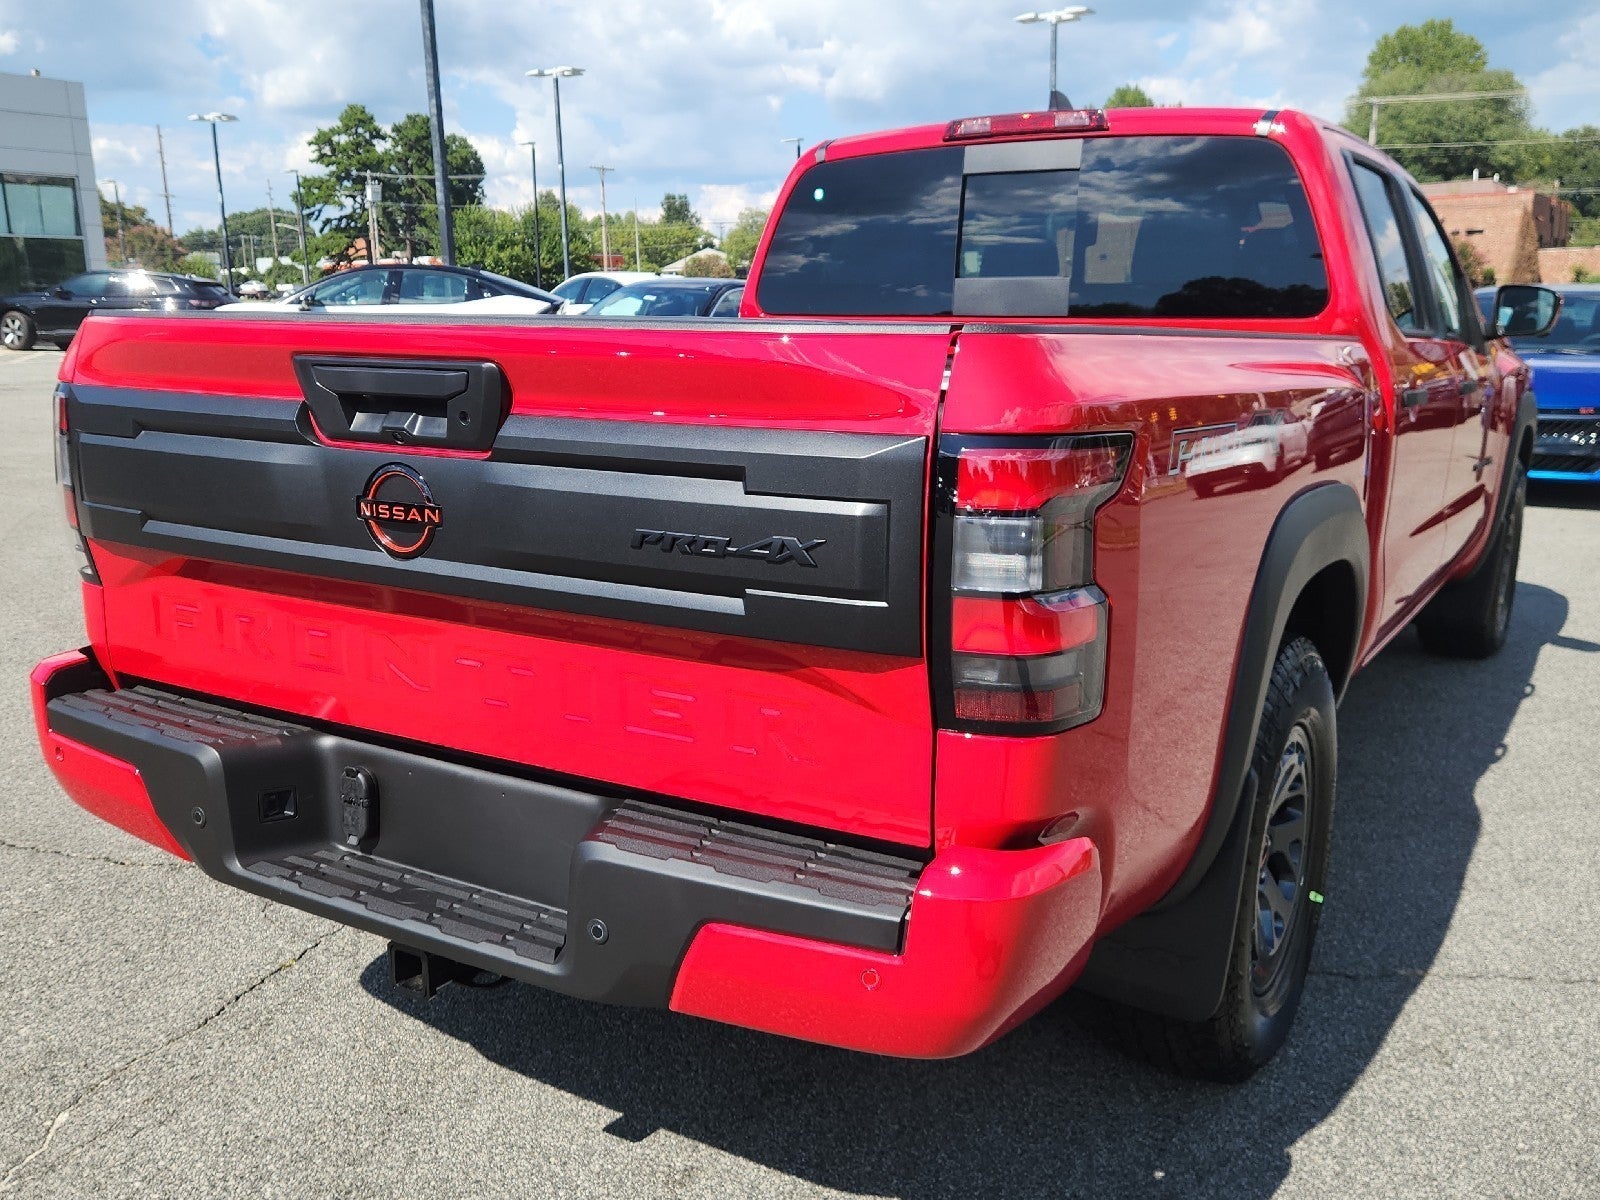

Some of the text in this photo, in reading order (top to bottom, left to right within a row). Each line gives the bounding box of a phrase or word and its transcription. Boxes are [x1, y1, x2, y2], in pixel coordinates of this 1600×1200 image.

[360, 501, 440, 523] NISSAN
[631, 528, 827, 568] PRO-4X
[152, 592, 824, 768] FRONTIER
